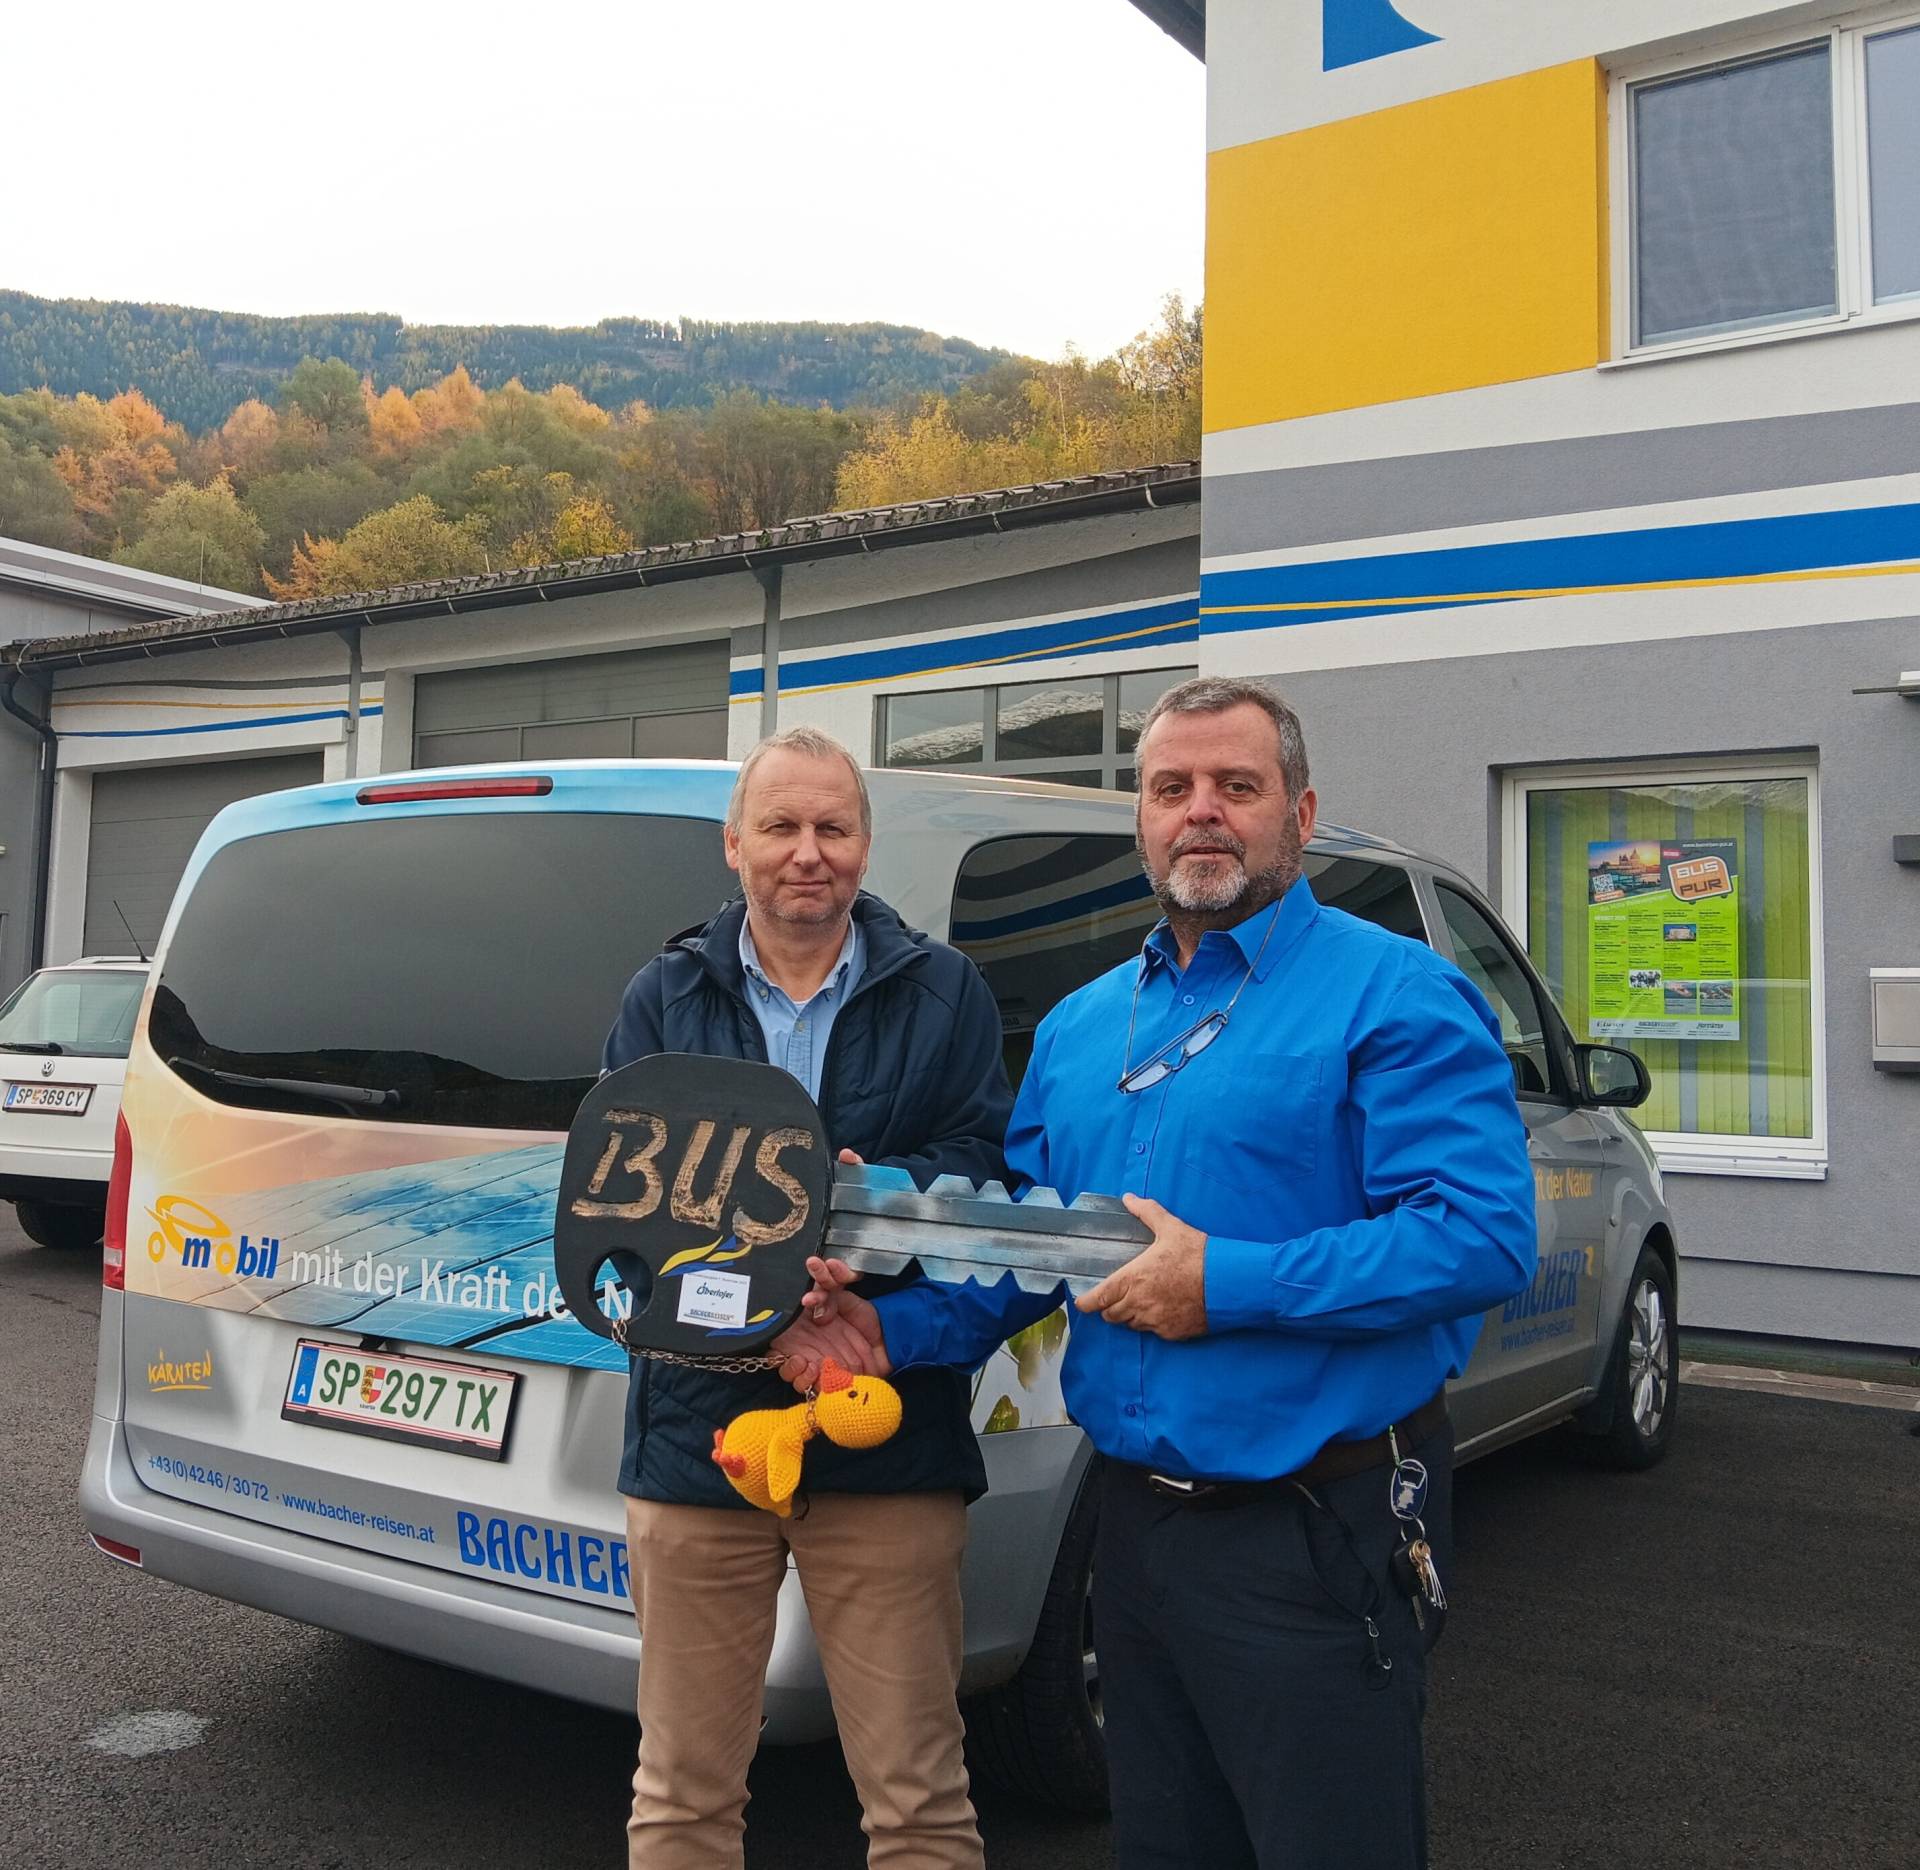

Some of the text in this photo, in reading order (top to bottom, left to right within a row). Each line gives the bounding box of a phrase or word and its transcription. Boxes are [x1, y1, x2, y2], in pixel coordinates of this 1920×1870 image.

[1676, 861, 1719, 879] BUS
[1679, 878, 1722, 896] PUR
[16, 1088, 84, 1107] SP 369 CY
[571, 1108, 814, 1245] BUS
[1547, 1168, 1564, 1201] der
[1566, 1167, 1593, 1198] Natur
[291, 1244, 344, 1289] mit
[353, 1251, 409, 1297] der
[421, 1258, 512, 1313] Kraft
[523, 1272, 571, 1320] de
[297, 1387, 306, 1397] A
[320, 1359, 498, 1433] SP 297 TX
[282, 1493, 435, 1544] www.bacher-reisen.at
[457, 1511, 631, 1598] BACHER
